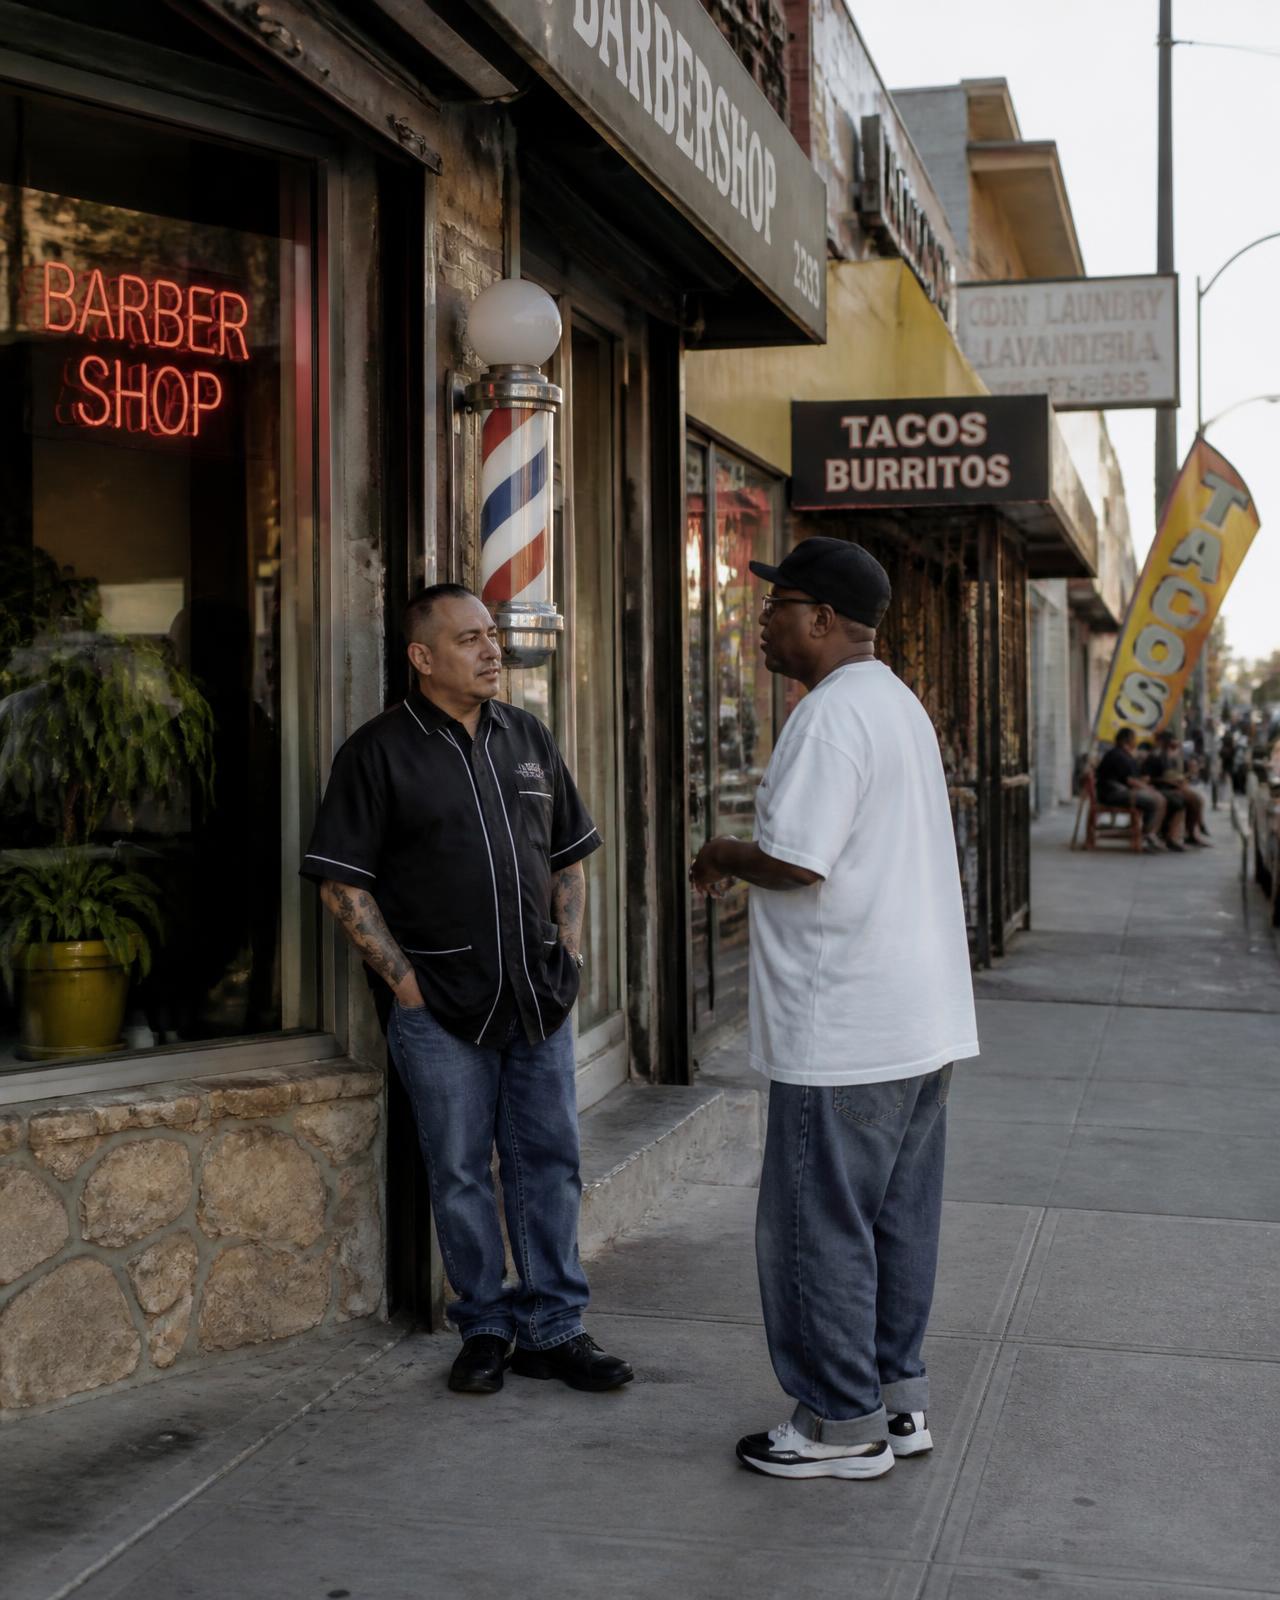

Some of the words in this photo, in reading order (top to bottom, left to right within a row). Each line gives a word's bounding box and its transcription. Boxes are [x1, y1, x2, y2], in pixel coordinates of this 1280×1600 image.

[43, 261, 249, 361] BARBER
[1044, 288, 1165, 324] LAUNDRY
[77, 354, 222, 437] SHOP
[841, 412, 988, 449] TACOS
[825, 453, 1011, 493] BURRITOS
[1114, 468, 1250, 731] TACOS
